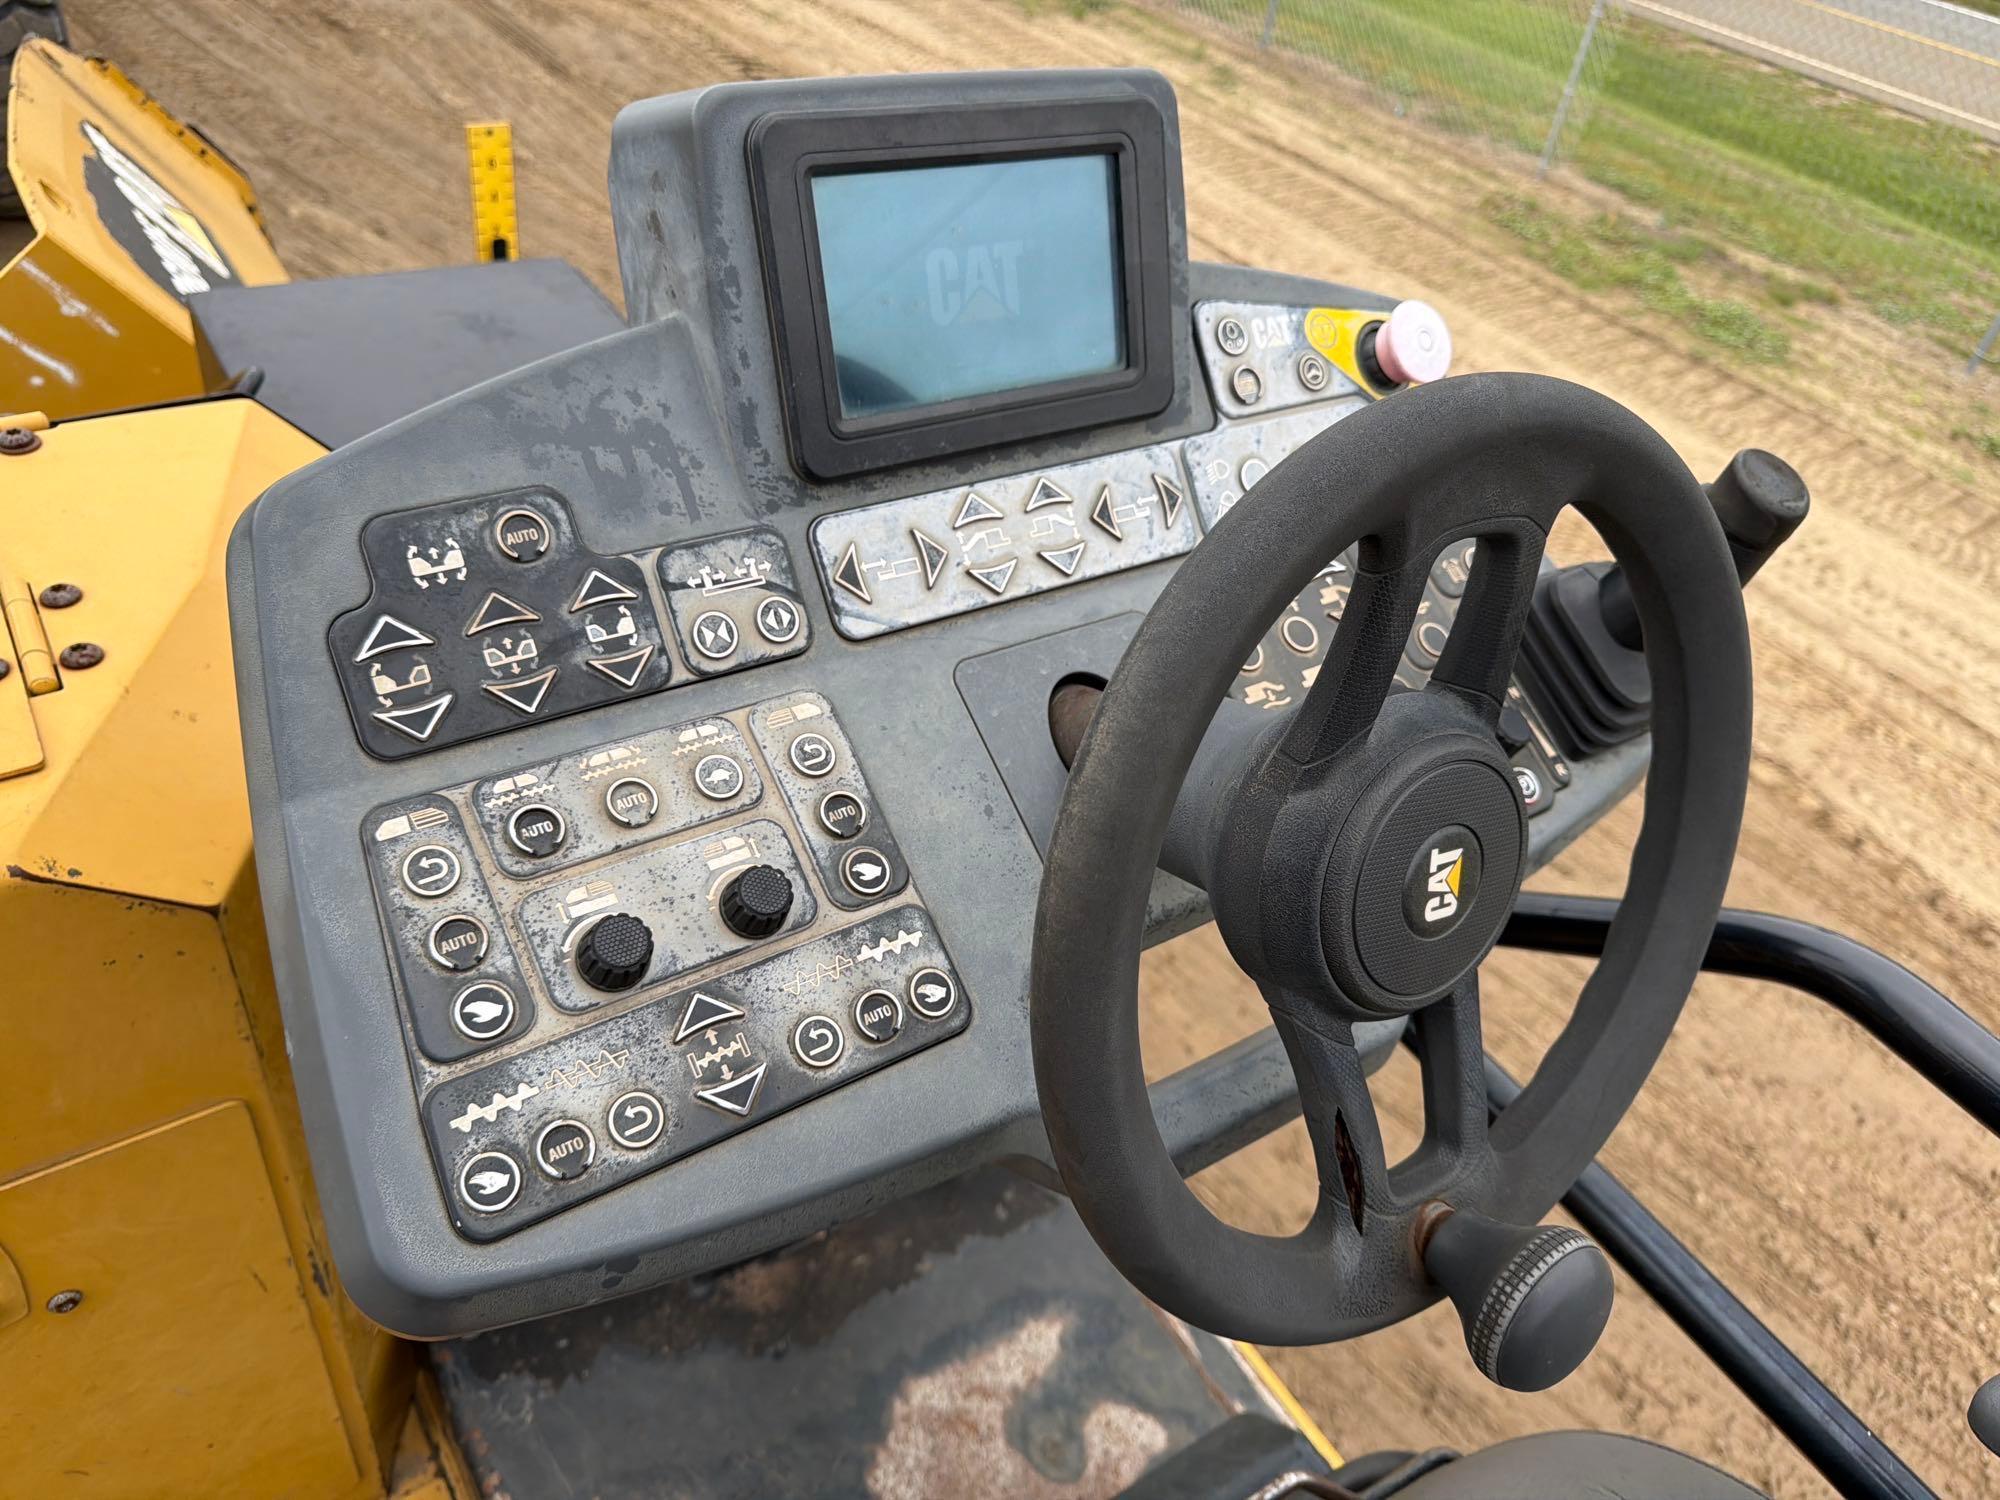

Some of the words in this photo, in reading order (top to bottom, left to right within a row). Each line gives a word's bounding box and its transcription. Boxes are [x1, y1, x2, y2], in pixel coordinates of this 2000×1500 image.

[926, 240, 1024, 326] CAT
[1252, 315, 1292, 349] CAT
[506, 527, 539, 546] AUTO
[616, 792, 648, 811] AUTO
[828, 804, 856, 823] AUTO
[520, 820, 554, 841] AUTO
[1424, 847, 1464, 923] CAT
[441, 931, 478, 955] AUTO
[863, 1004, 892, 1026] AUTO
[548, 1136, 584, 1163] AUTO
